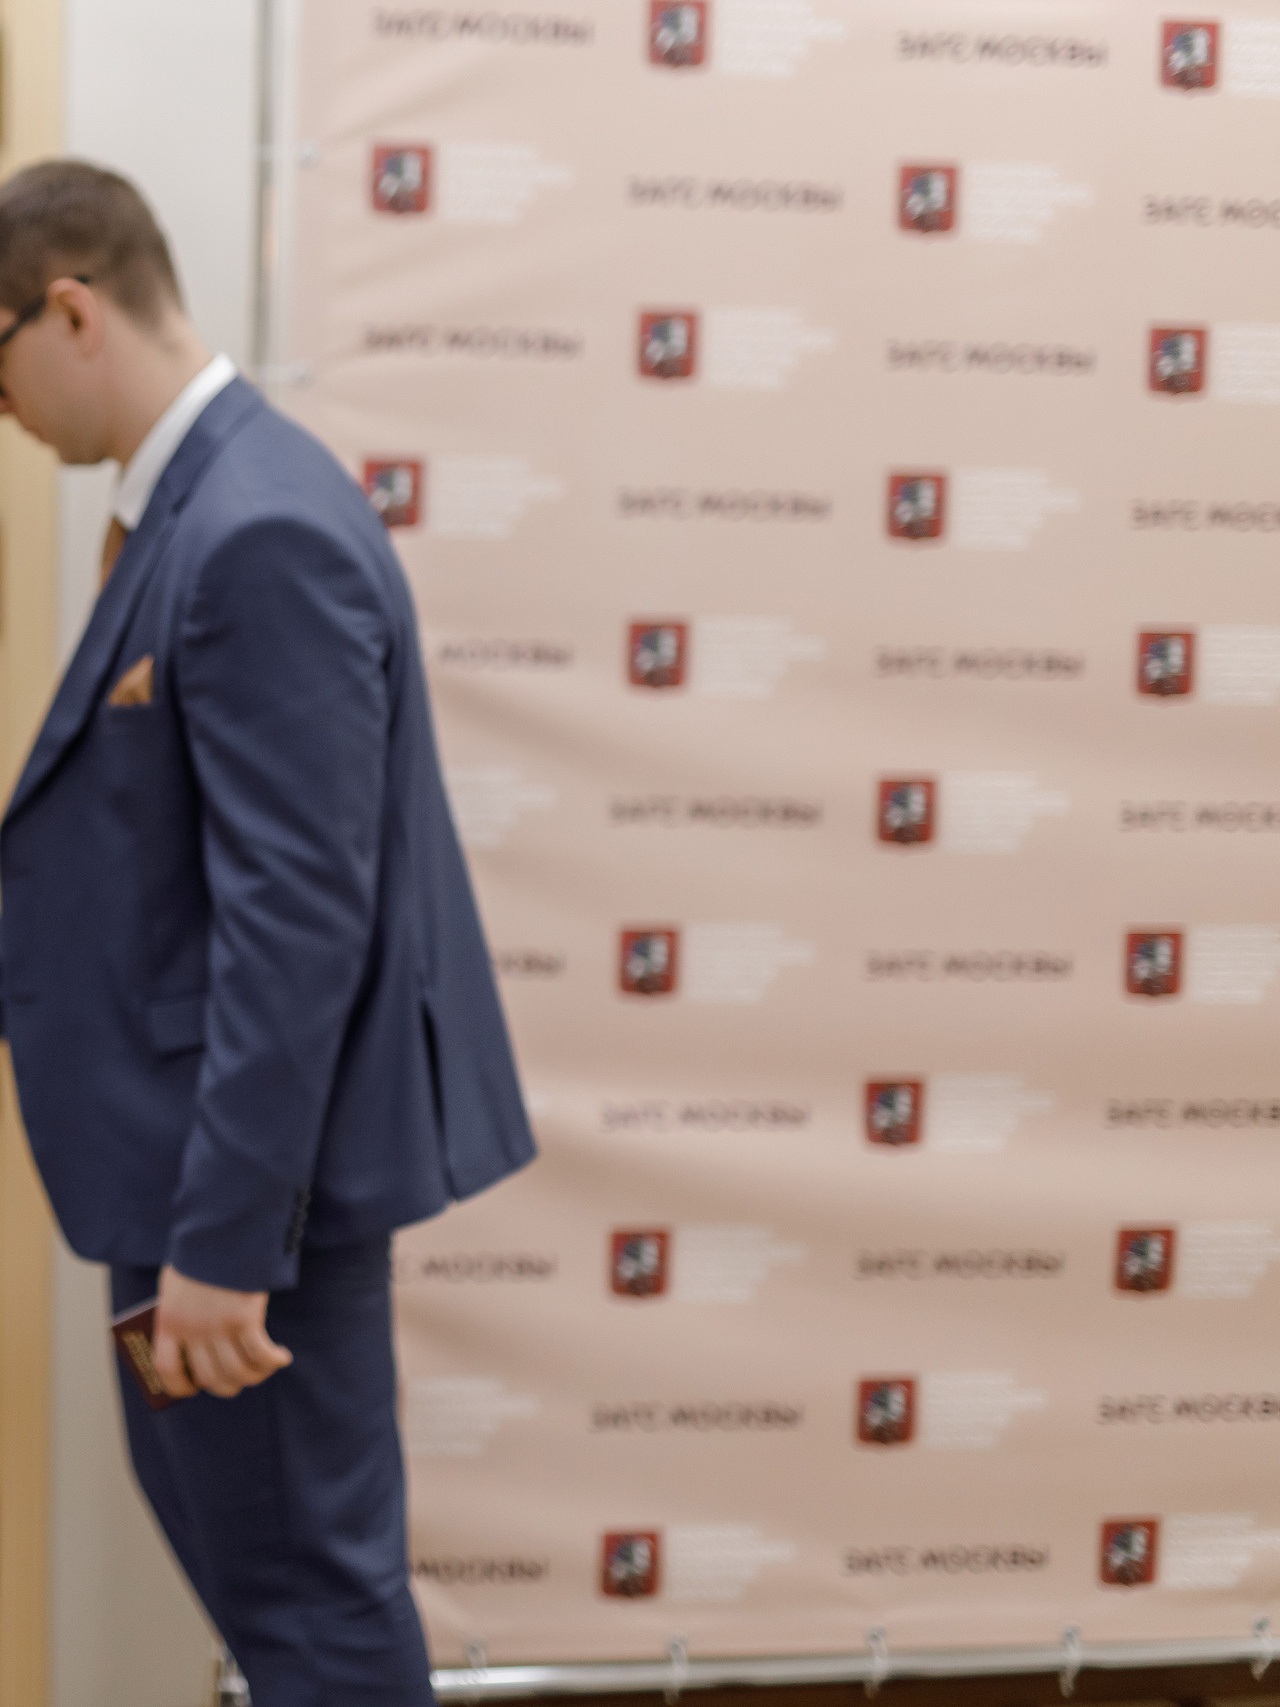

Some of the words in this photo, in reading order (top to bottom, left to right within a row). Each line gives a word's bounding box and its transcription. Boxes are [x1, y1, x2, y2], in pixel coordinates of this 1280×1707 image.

[375, 10, 443, 40] ЗАГС
[449, 13, 591, 44] МОСКВЫ
[899, 31, 966, 62] ЗАГС
[973, 36, 1106, 66] МОСКВЫ
[629, 177, 695, 207] ЗАГС
[703, 181, 841, 211] МОСКВЫ
[1143, 196, 1210, 226] ЗАГС
[364, 322, 432, 355] ЗАГС
[440, 328, 580, 357] МОСКВЫ
[887, 340, 954, 371] ЗАГС
[962, 344, 1094, 374] МОСКВЫ
[618, 488, 686, 519] ЗАГС
[693, 491, 830, 521] МОСКВЫ
[1132, 500, 1198, 530] ЗАГС
[1205, 502, 1280, 531] МОС
[440, 639, 573, 668] МОСКВЫ
[876, 649, 943, 678] ЗАГС
[952, 650, 1083, 679] МОСКВЫ
[611, 794, 677, 826] ЗАГС
[686, 797, 821, 827] МОСКВЫ
[1120, 802, 1186, 832] ЗАГС
[867, 950, 933, 981] ЗАГС
[941, 952, 1071, 981] МОСКВЫ
[601, 1102, 669, 1131] ЗАГС
[677, 1101, 809, 1129] МОСКВЫ
[1107, 1098, 1173, 1127] ЗАГС
[421, 1254, 555, 1281] МОСКВЫ
[857, 1249, 924, 1279] ЗАГС
[932, 1250, 1062, 1278] МОСКВЫ
[592, 1402, 660, 1431] ЗАГС
[667, 1403, 801, 1430] МОСКВЫ
[1099, 1395, 1164, 1425] ЗАГС
[845, 1547, 911, 1575] ЗАГС
[918, 1546, 1048, 1572] МОСКВЫ
